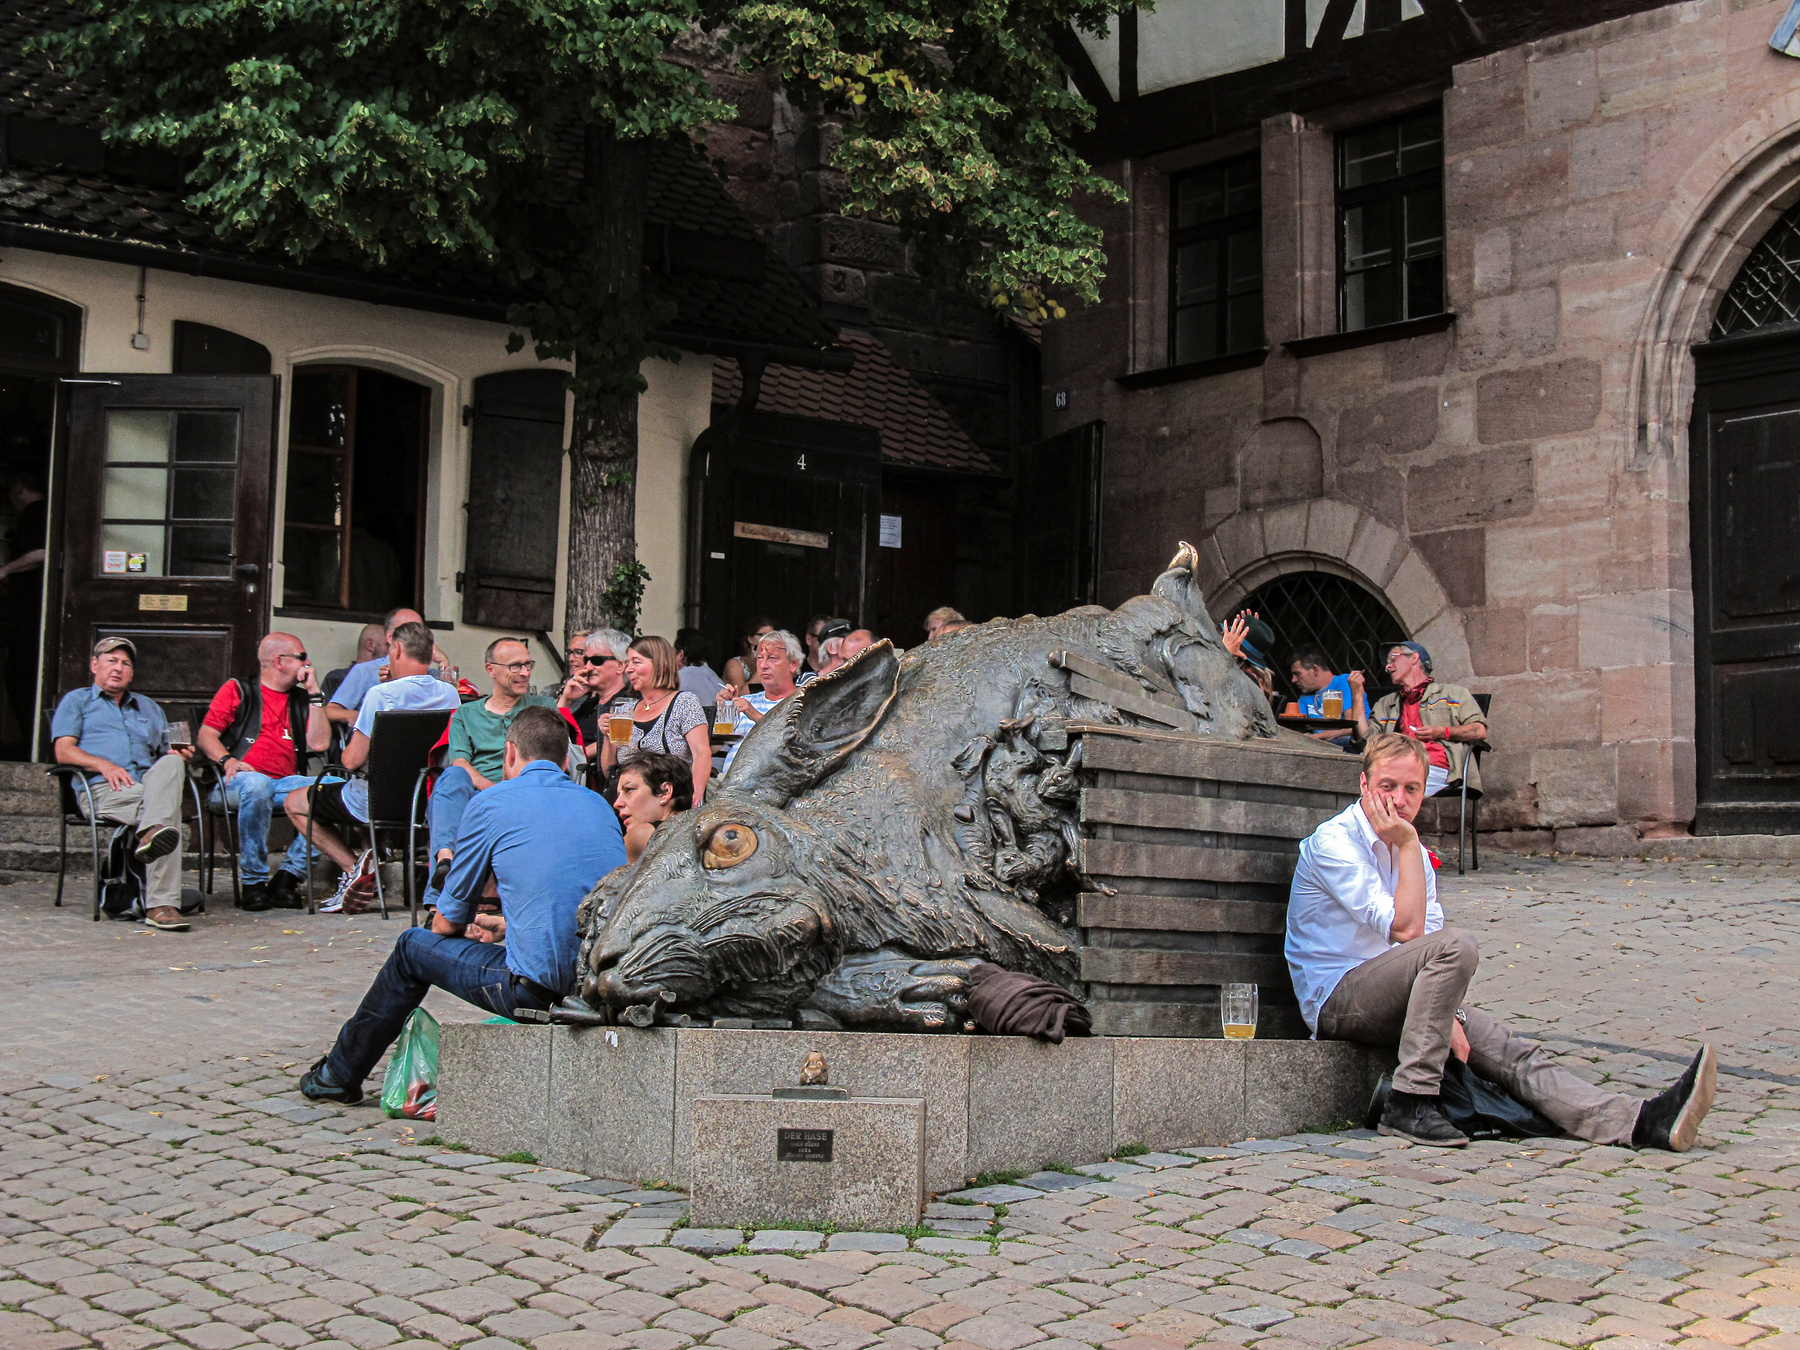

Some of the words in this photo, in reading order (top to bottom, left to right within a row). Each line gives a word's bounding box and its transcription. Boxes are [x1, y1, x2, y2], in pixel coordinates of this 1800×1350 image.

[1055, 391, 1066, 408] 68
[797, 453, 806, 470] 4
[784, 1132, 801, 1140] DER
[804, 1132, 827, 1141] HASE
